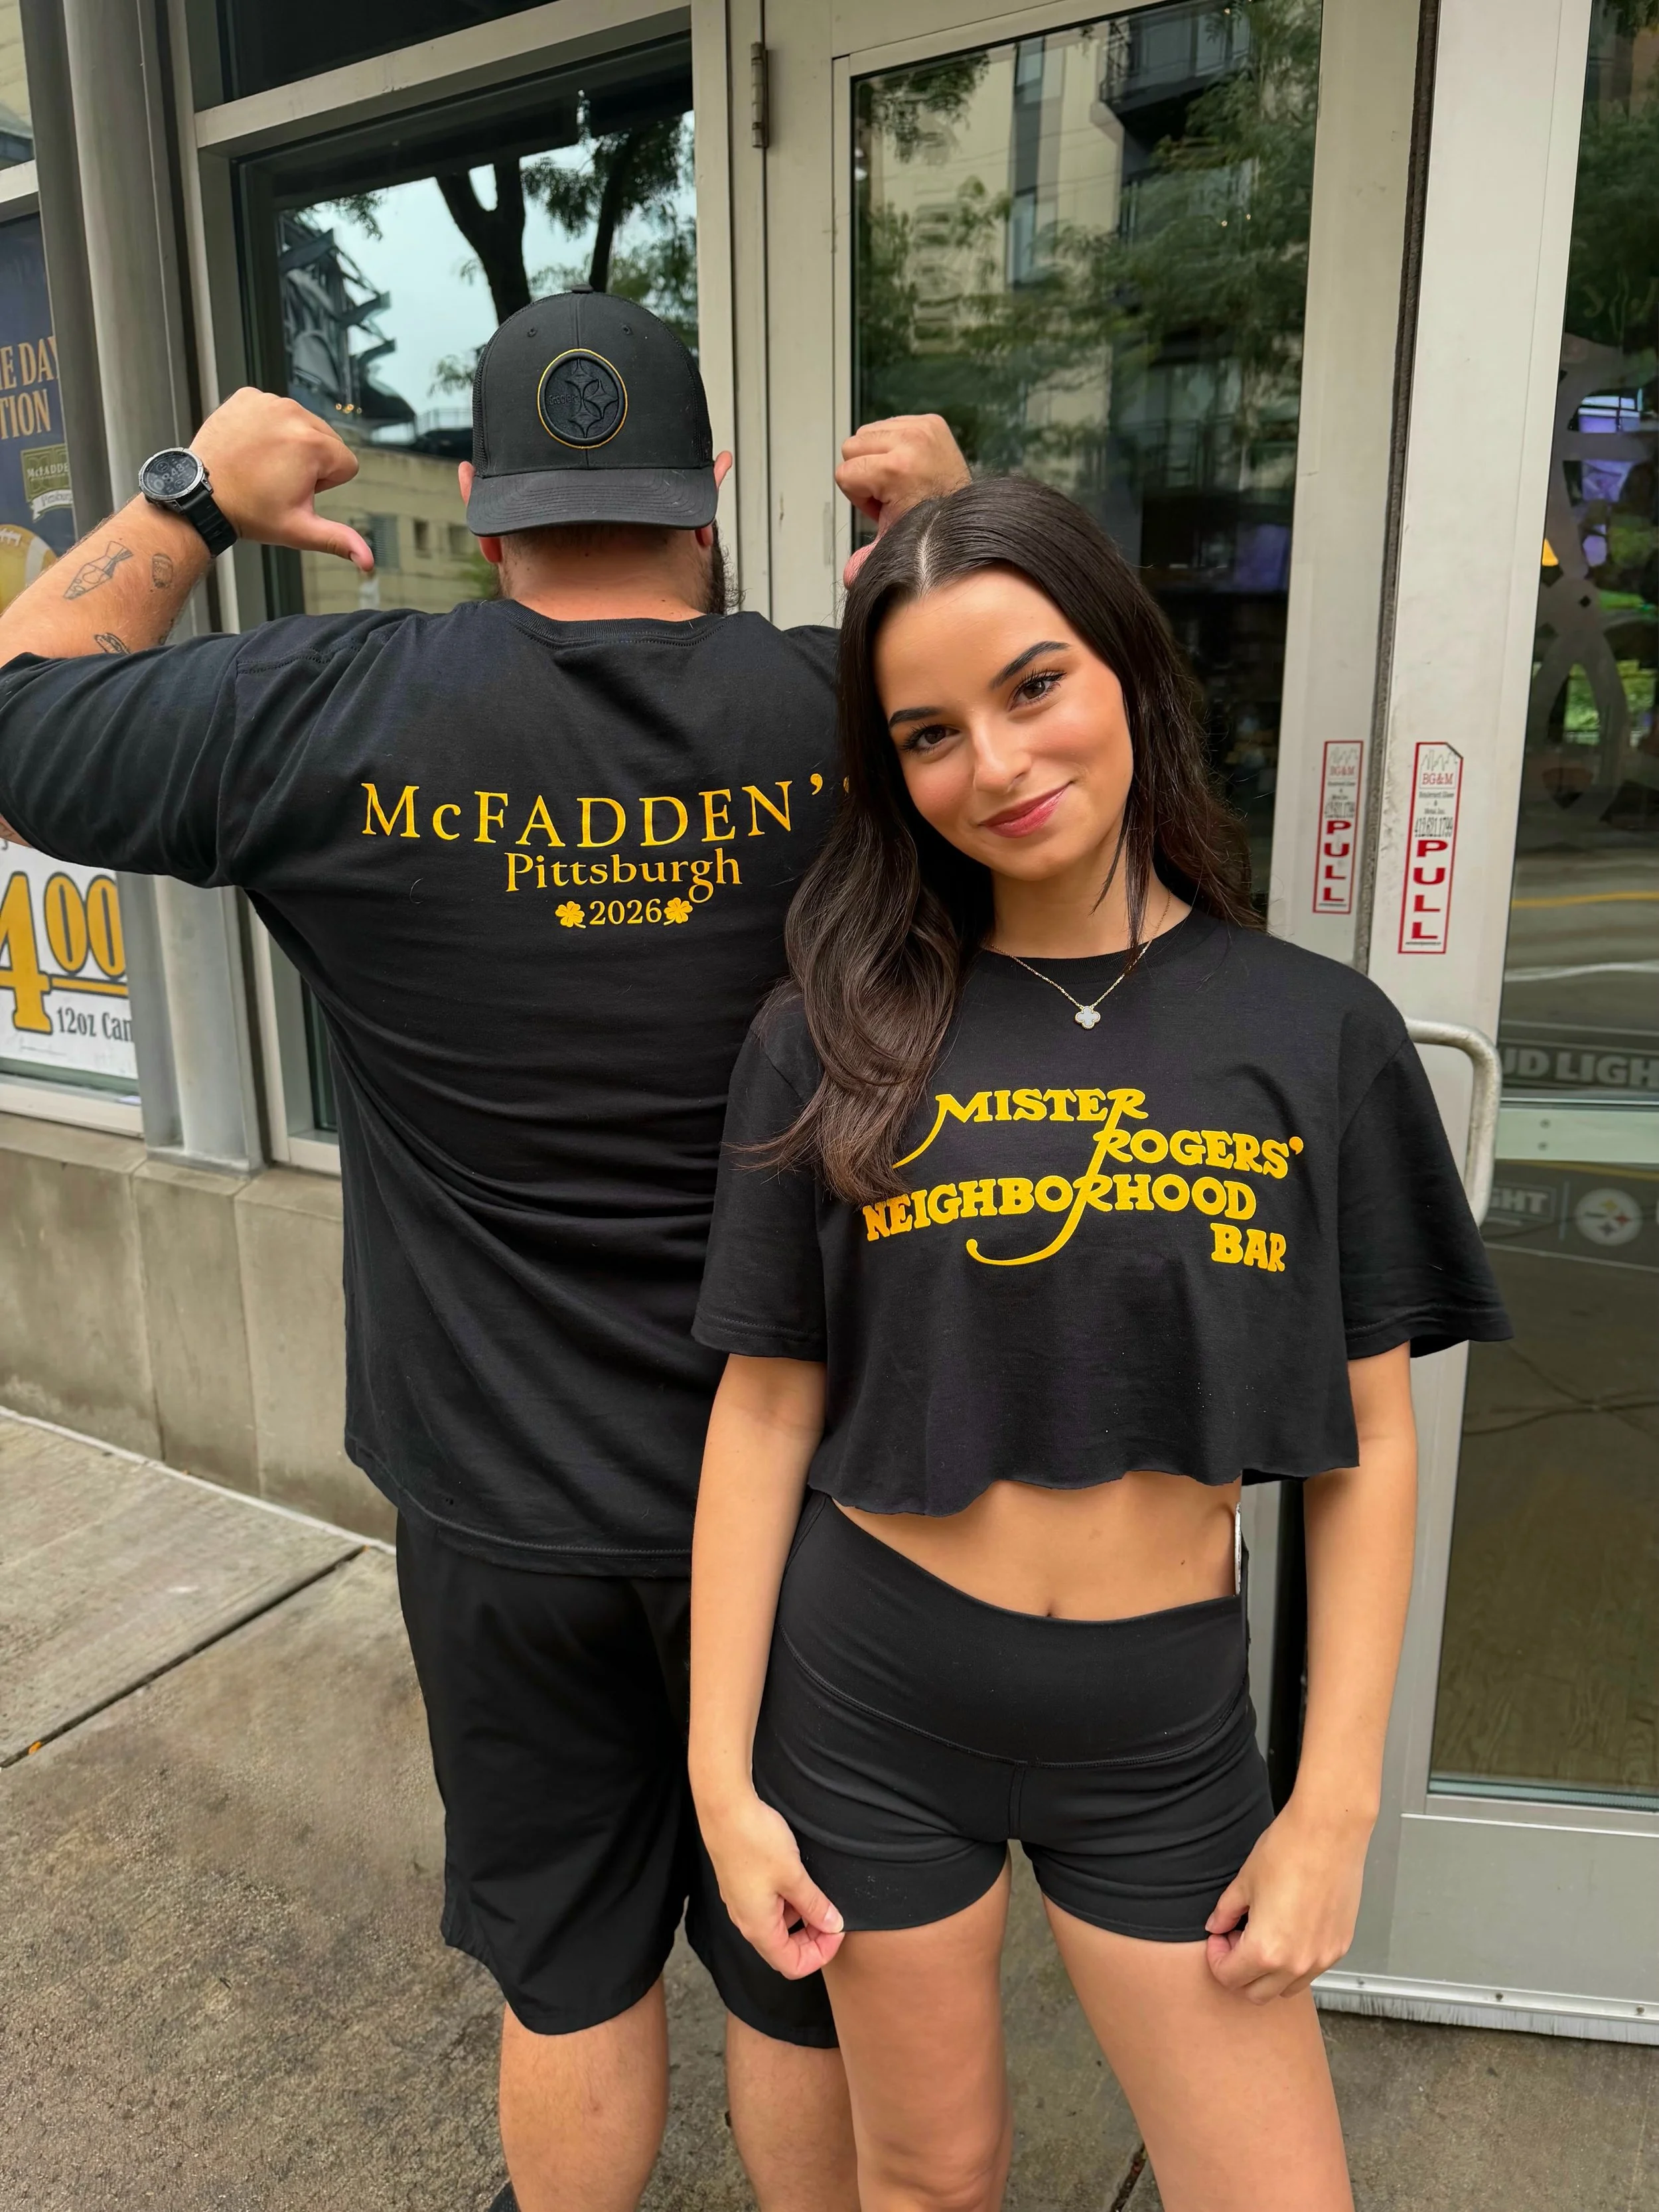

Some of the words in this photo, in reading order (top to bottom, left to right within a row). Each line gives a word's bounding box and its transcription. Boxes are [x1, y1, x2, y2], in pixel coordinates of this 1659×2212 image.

[0, 345, 17, 390] E
[1422, 773, 1453, 785] BG&M
[361, 773, 851, 847] McFADDEN'
[504, 848, 742, 903] Pittsburgh
[1323, 820, 1352, 902] PULL
[589, 900, 662, 926] 2026
[1411, 840, 1449, 939] PULL
[56, 1005, 98, 1037] 12oz
[1092, 1128, 1304, 1179] ROGERS'
[863, 1173, 1256, 1265] NEIGHBORHOOD
[1210, 1223, 1285, 1272] BAR
